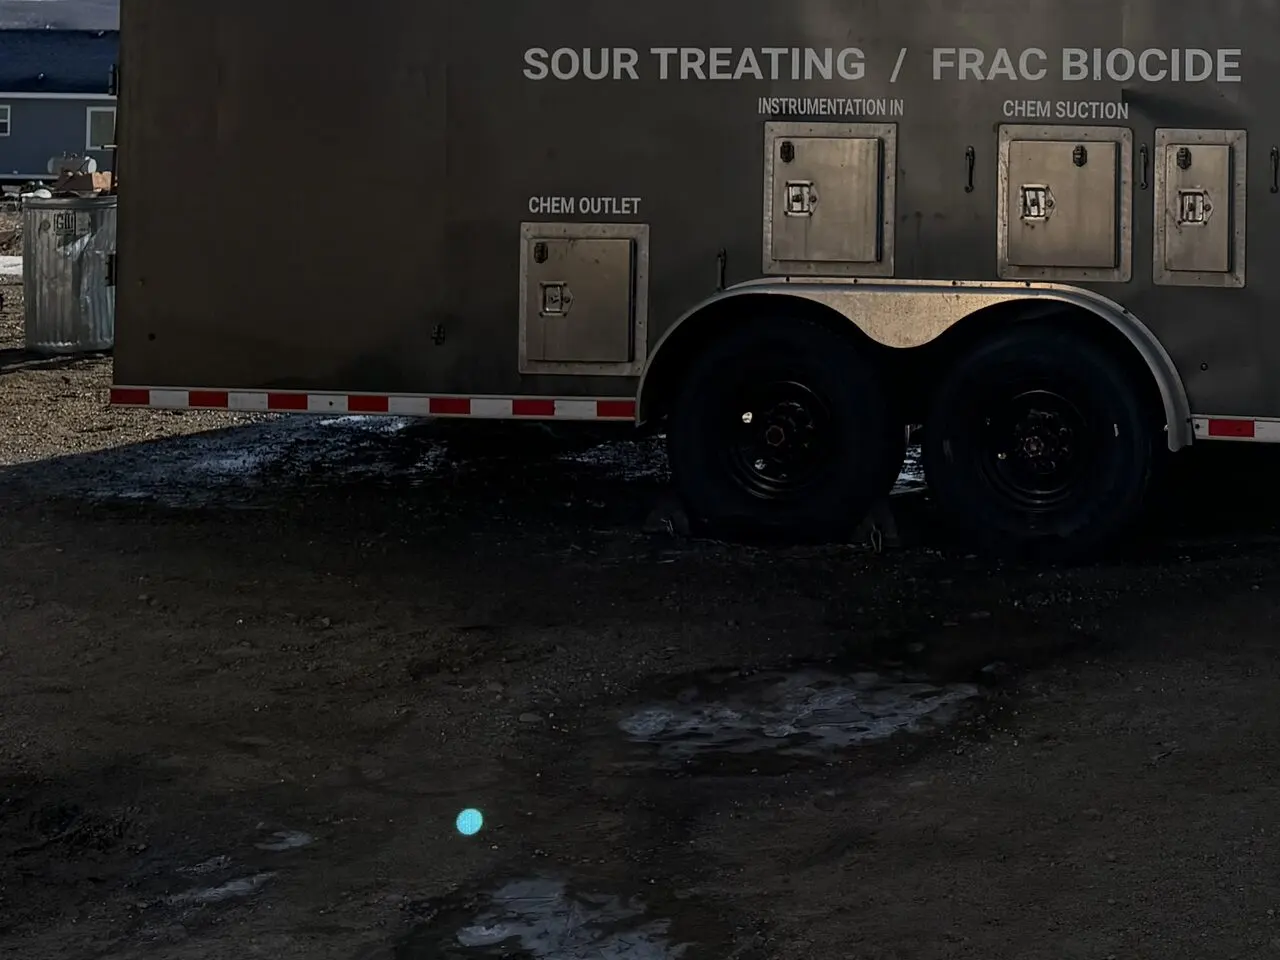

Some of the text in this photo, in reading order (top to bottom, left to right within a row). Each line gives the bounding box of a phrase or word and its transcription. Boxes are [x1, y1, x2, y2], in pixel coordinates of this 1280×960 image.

[523, 46, 1242, 83] SOUR TREATING / FRAC BIOCIDE
[758, 97, 904, 117] INSTRUMENTATION IN
[1002, 99, 1130, 120] CHEM SUCTION
[528, 196, 642, 215] CHEM OUTLET
